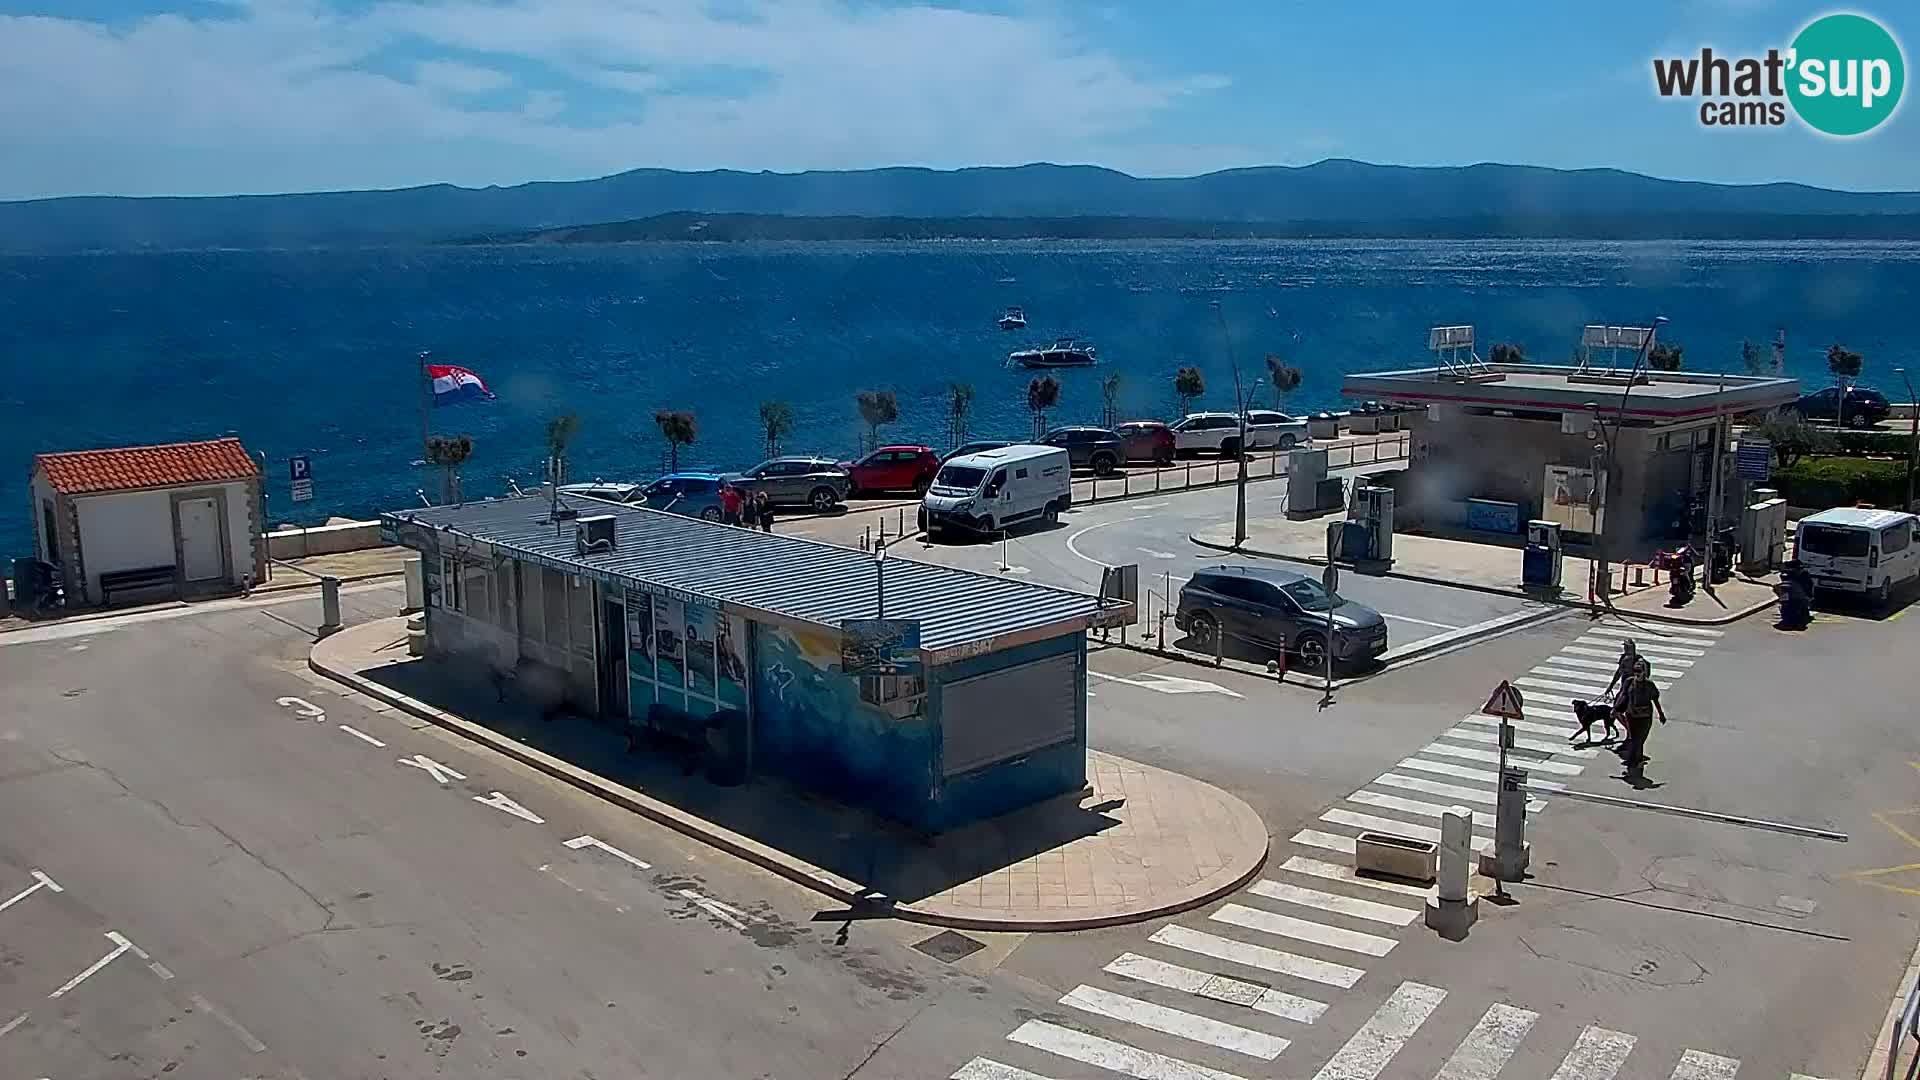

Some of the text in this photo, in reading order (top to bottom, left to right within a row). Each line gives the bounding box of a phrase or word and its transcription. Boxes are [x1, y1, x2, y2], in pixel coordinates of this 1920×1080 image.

[294, 460, 305, 477] P
[634, 580, 667, 598] STATION
[667, 589, 694, 604] TICKET
[693, 596, 721, 610] OFFICE
